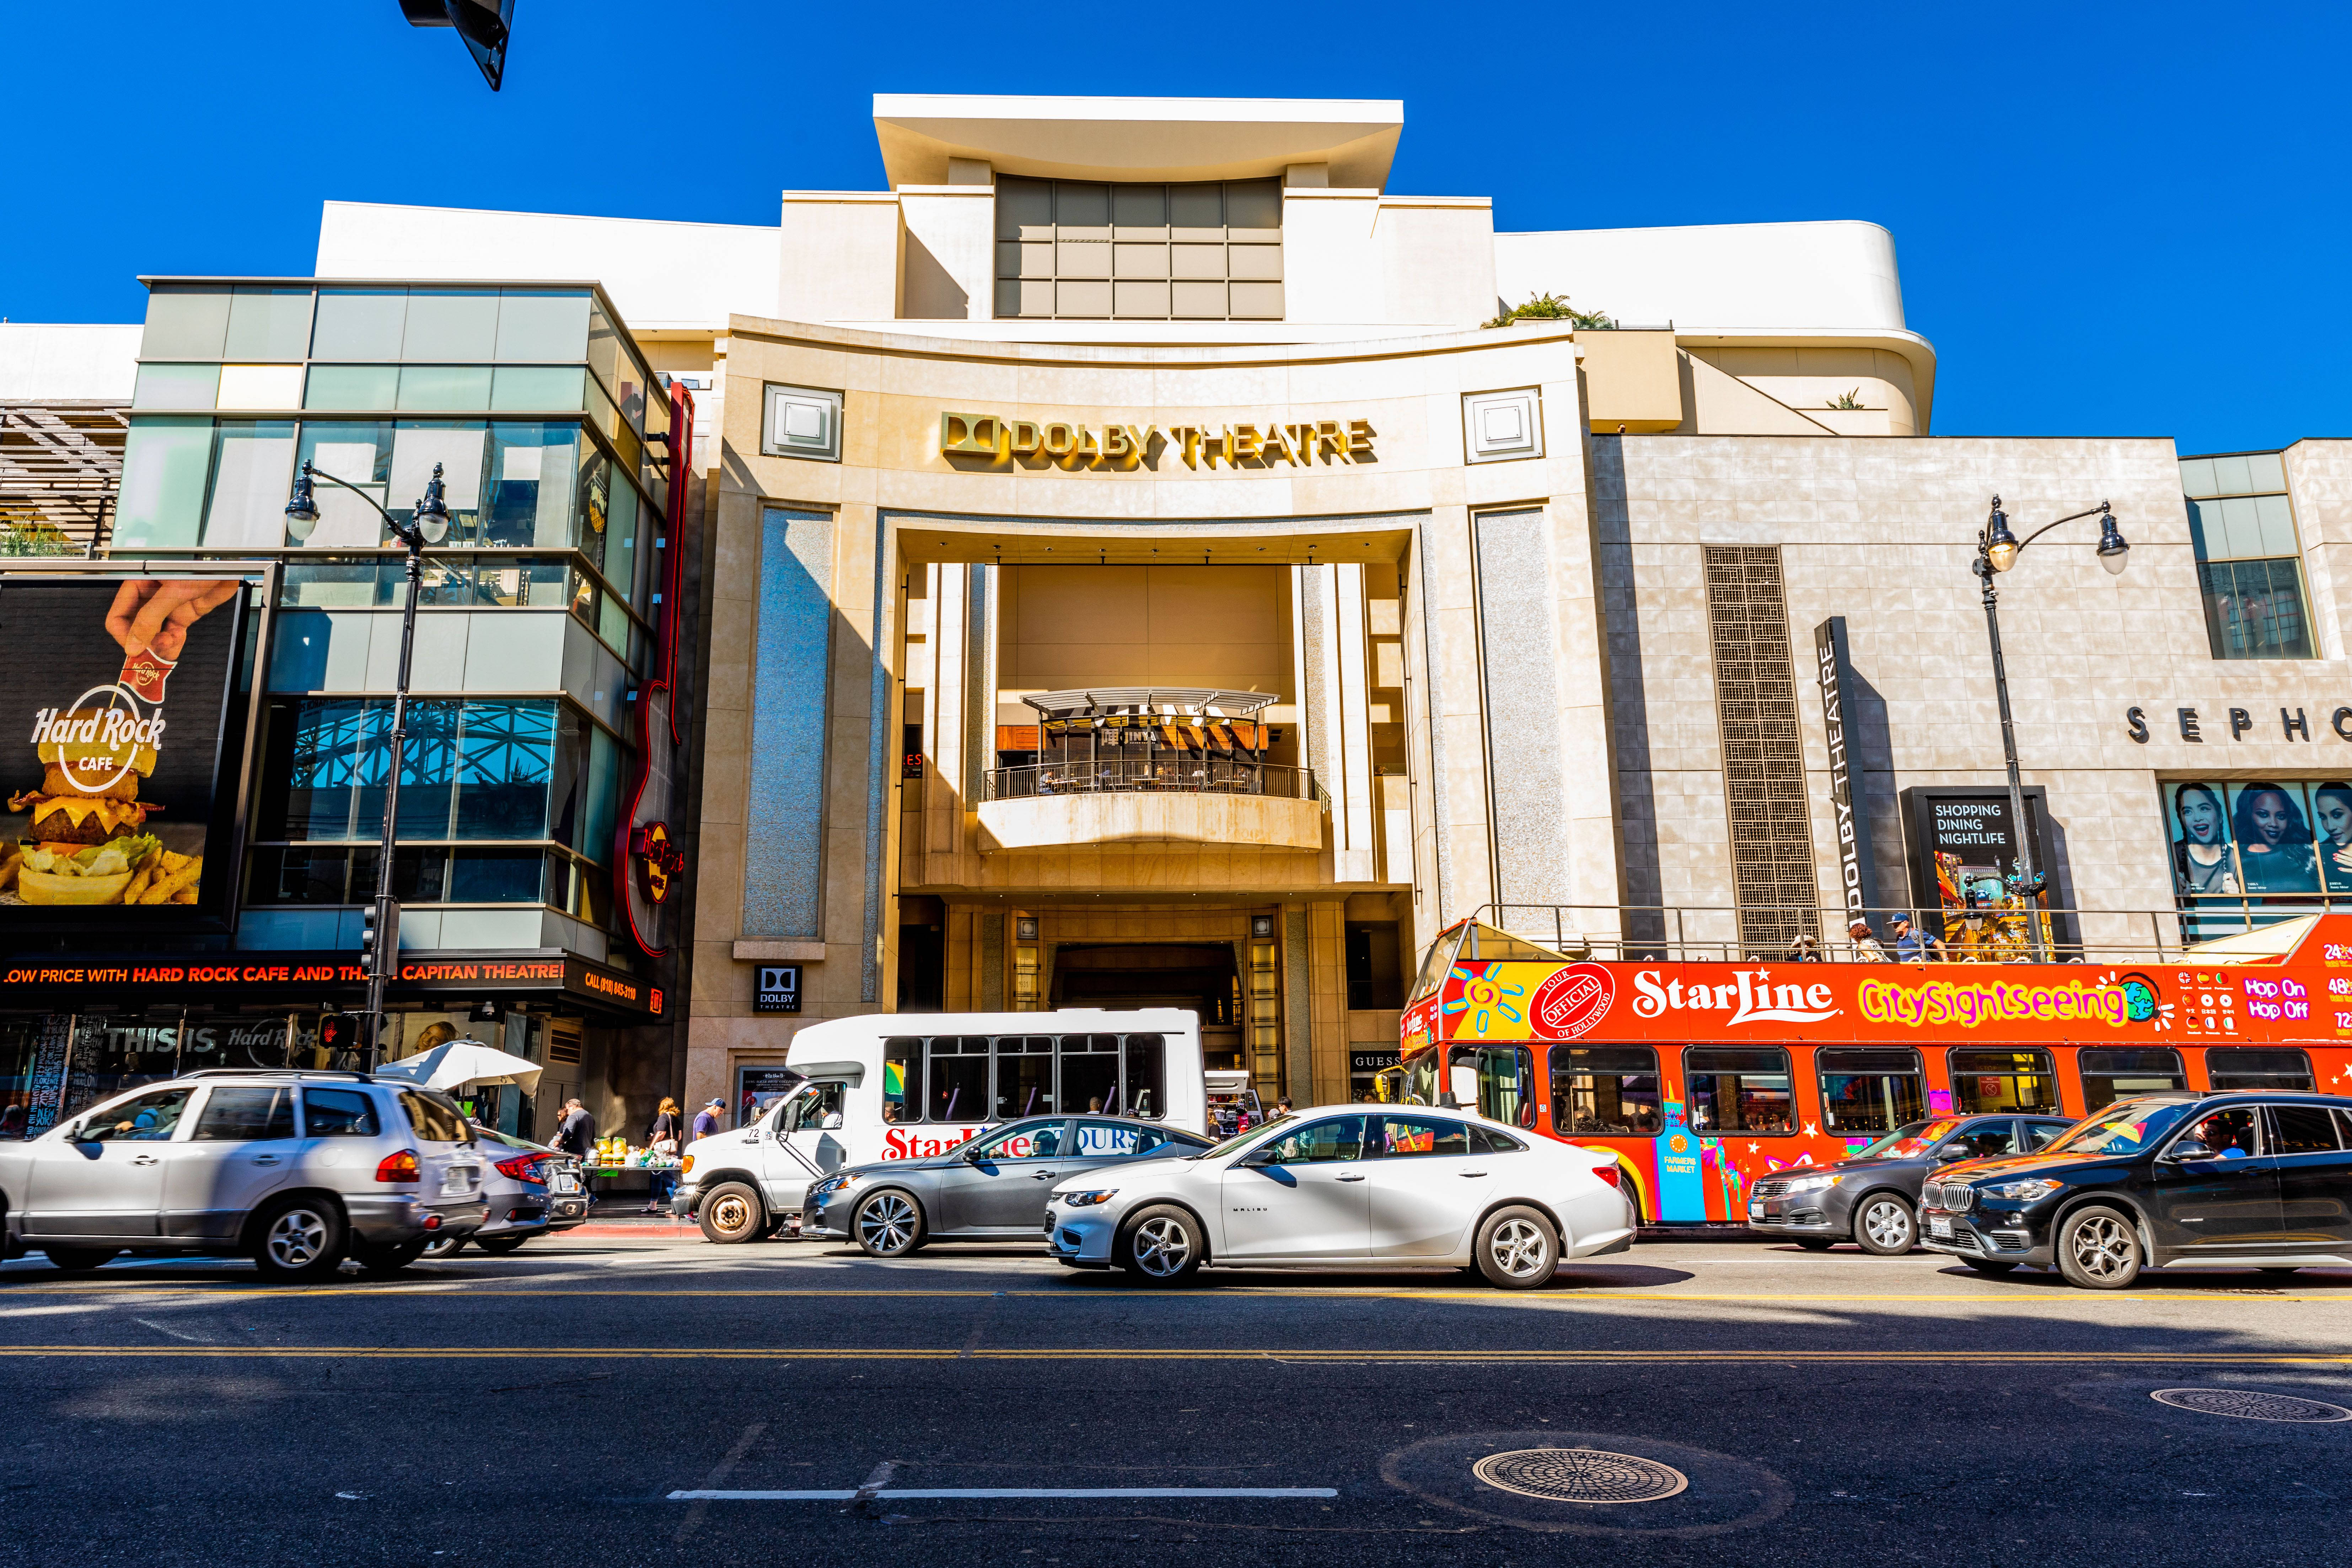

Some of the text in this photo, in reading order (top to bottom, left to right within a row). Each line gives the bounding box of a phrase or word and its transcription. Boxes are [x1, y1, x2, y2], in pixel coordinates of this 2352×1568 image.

[1011, 418, 1371, 458] DOLBY THEATRE
[31, 708, 166, 751] Hard Rock
[1124, 732, 1156, 744] JINYA
[79, 757, 112, 771] CAFE
[1820, 641, 1862, 912] DOLBY THEATRE
[1936, 805, 2001, 816] SHOPPING
[1937, 819, 1983, 830] DINING
[1939, 833, 2006, 844] NIGHTLIFE
[2324, 944, 2342, 960] 24
[40, 970, 84, 982] PRICE
[87, 969, 128, 982] WITH
[133, 967, 184, 982] HARD
[188, 967, 240, 982] ROCK
[243, 967, 289, 981] CAFE
[293, 966, 335, 981] AND
[402, 965, 478, 980] CAPITAN
[482, 964, 565, 979] THEATRE!
[1542, 970, 1570, 992] TOUR
[585, 972, 636, 1000] CALL (818) 845-3110
[2245, 979, 2306, 999] Hop On
[2329, 978, 2348, 994] 48
[760, 994, 794, 1003] DOLBY
[1546, 978, 1599, 1022] OFFICIAL
[1632, 966, 1840, 1027] StarLine
[1557, 992, 1611, 1038] OF HOLLYWOOD
[2249, 1000, 2308, 1020] Hop Off
[2334, 1012, 2352, 1028] 72
[106, 1027, 177, 1052] THIS
[187, 1027, 217, 1052] IS
[228, 1028, 317, 1050] Hard Rck
[1355, 1057, 1401, 1066] GUESS
[32, 1085, 41, 1096] CITY
[30, 1097, 39, 1112] MINH
[28, 1114, 37, 1124] CHI
[36, 1116, 54, 1126] YORK
[37, 1108, 55, 1118] NEW
[749, 1129, 759, 1137] 72
[1664, 1156, 1696, 1165] FARMERS
[1667, 1165, 1695, 1173] MARKET
